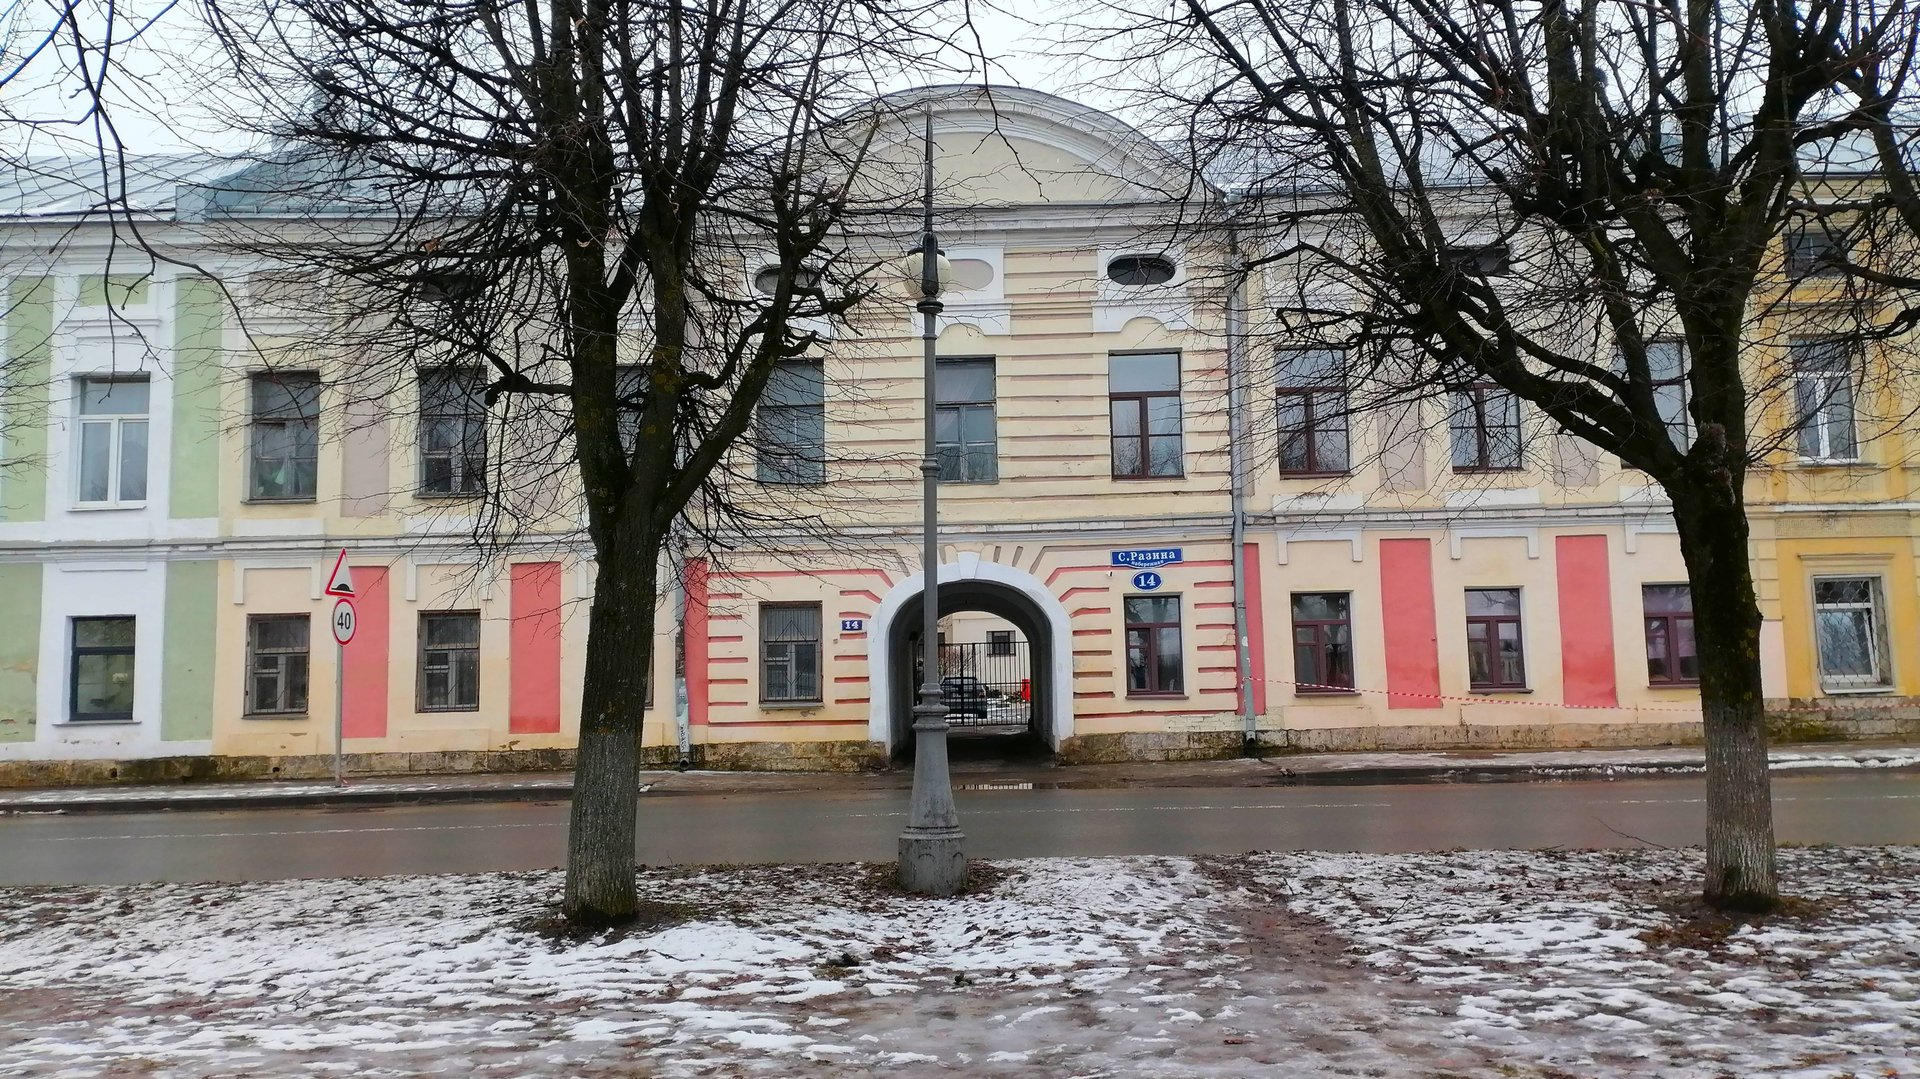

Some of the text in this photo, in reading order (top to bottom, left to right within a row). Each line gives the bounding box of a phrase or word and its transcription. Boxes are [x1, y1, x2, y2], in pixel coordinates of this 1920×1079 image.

[1118, 551, 1176, 562] С.Разина
[1138, 574, 1157, 587] 14
[337, 611, 351, 630] 40
[845, 620, 859, 630] 14
